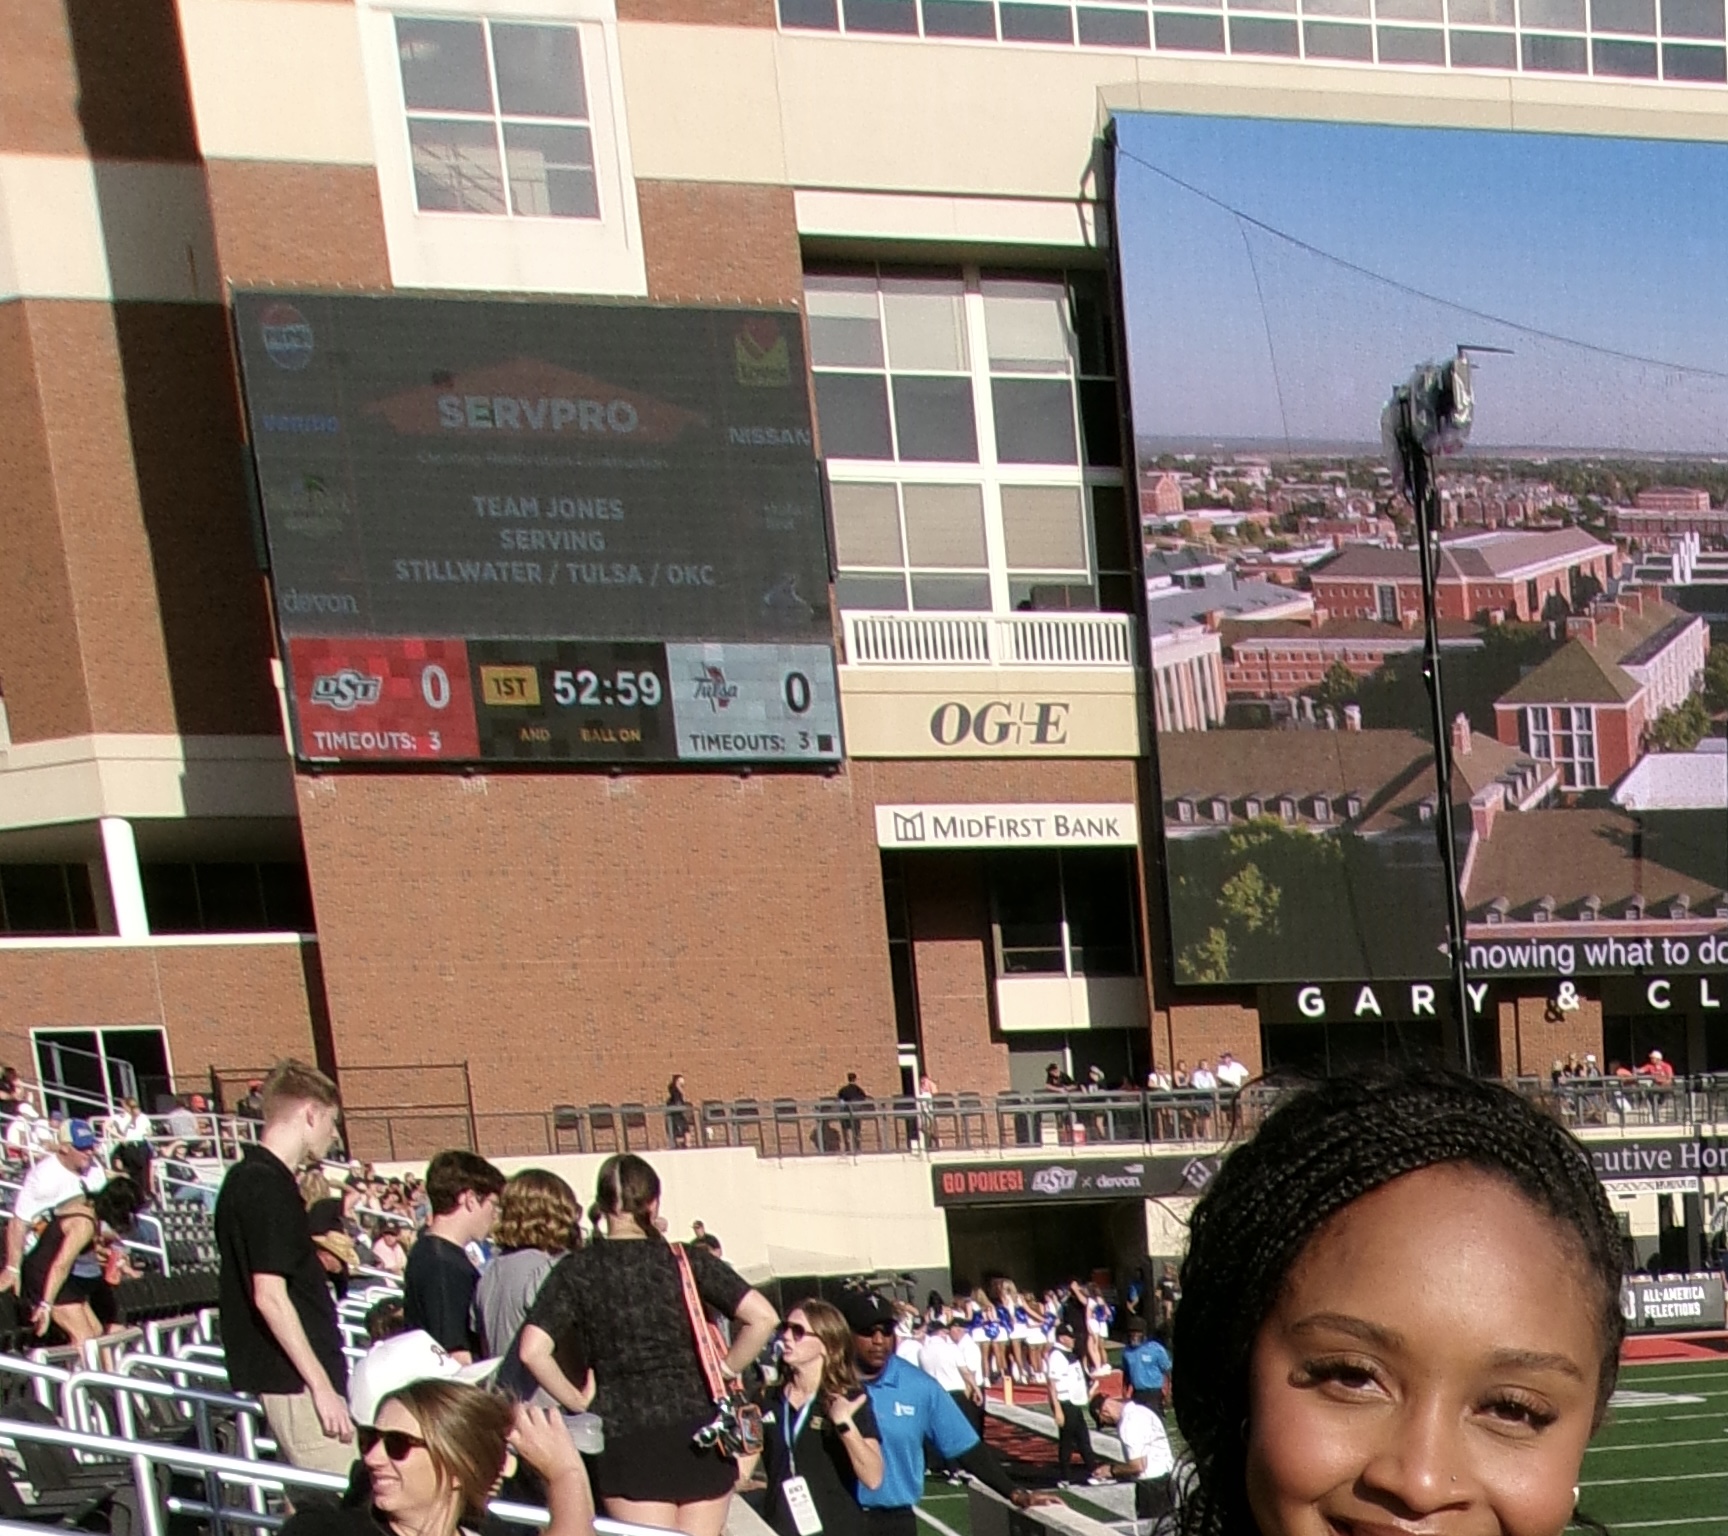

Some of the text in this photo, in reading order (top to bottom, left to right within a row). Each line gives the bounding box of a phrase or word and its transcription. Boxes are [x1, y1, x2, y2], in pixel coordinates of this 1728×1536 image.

[438, 395, 639, 433] SERVPRO
[729, 427, 811, 447] NISSAN
[471, 496, 625, 521] TEAM JONES
[499, 529, 606, 551] SERVING
[393, 558, 542, 584] STILLWATER
[566, 563, 643, 585] TULSA
[667, 563, 715, 587] OKC
[282, 588, 359, 614] devon
[421, 664, 450, 709] 0
[494, 677, 528, 697] 1ST
[553, 669, 663, 706] 52:59
[692, 676, 739, 701] Tulsa
[784, 670, 812, 714] 0
[313, 730, 443, 751] TIMEOUTS: 3
[689, 731, 811, 752] TIMEOUTS: 3
[1584, 936, 1654, 967] what
[1661, 938, 1690, 966] to
[1297, 983, 1490, 1019] GARY
[1557, 980, 1580, 1012] &
[1592, 1143, 1673, 1171] cutive
[942, 1171, 966, 1194] GO
[968, 1168, 1025, 1193] POKES!
[1095, 1173, 1141, 1191] devon
[1642, 1285, 1706, 1303] ALL-AMERICA
[1643, 1302, 1701, 1319] SELECTIONS
